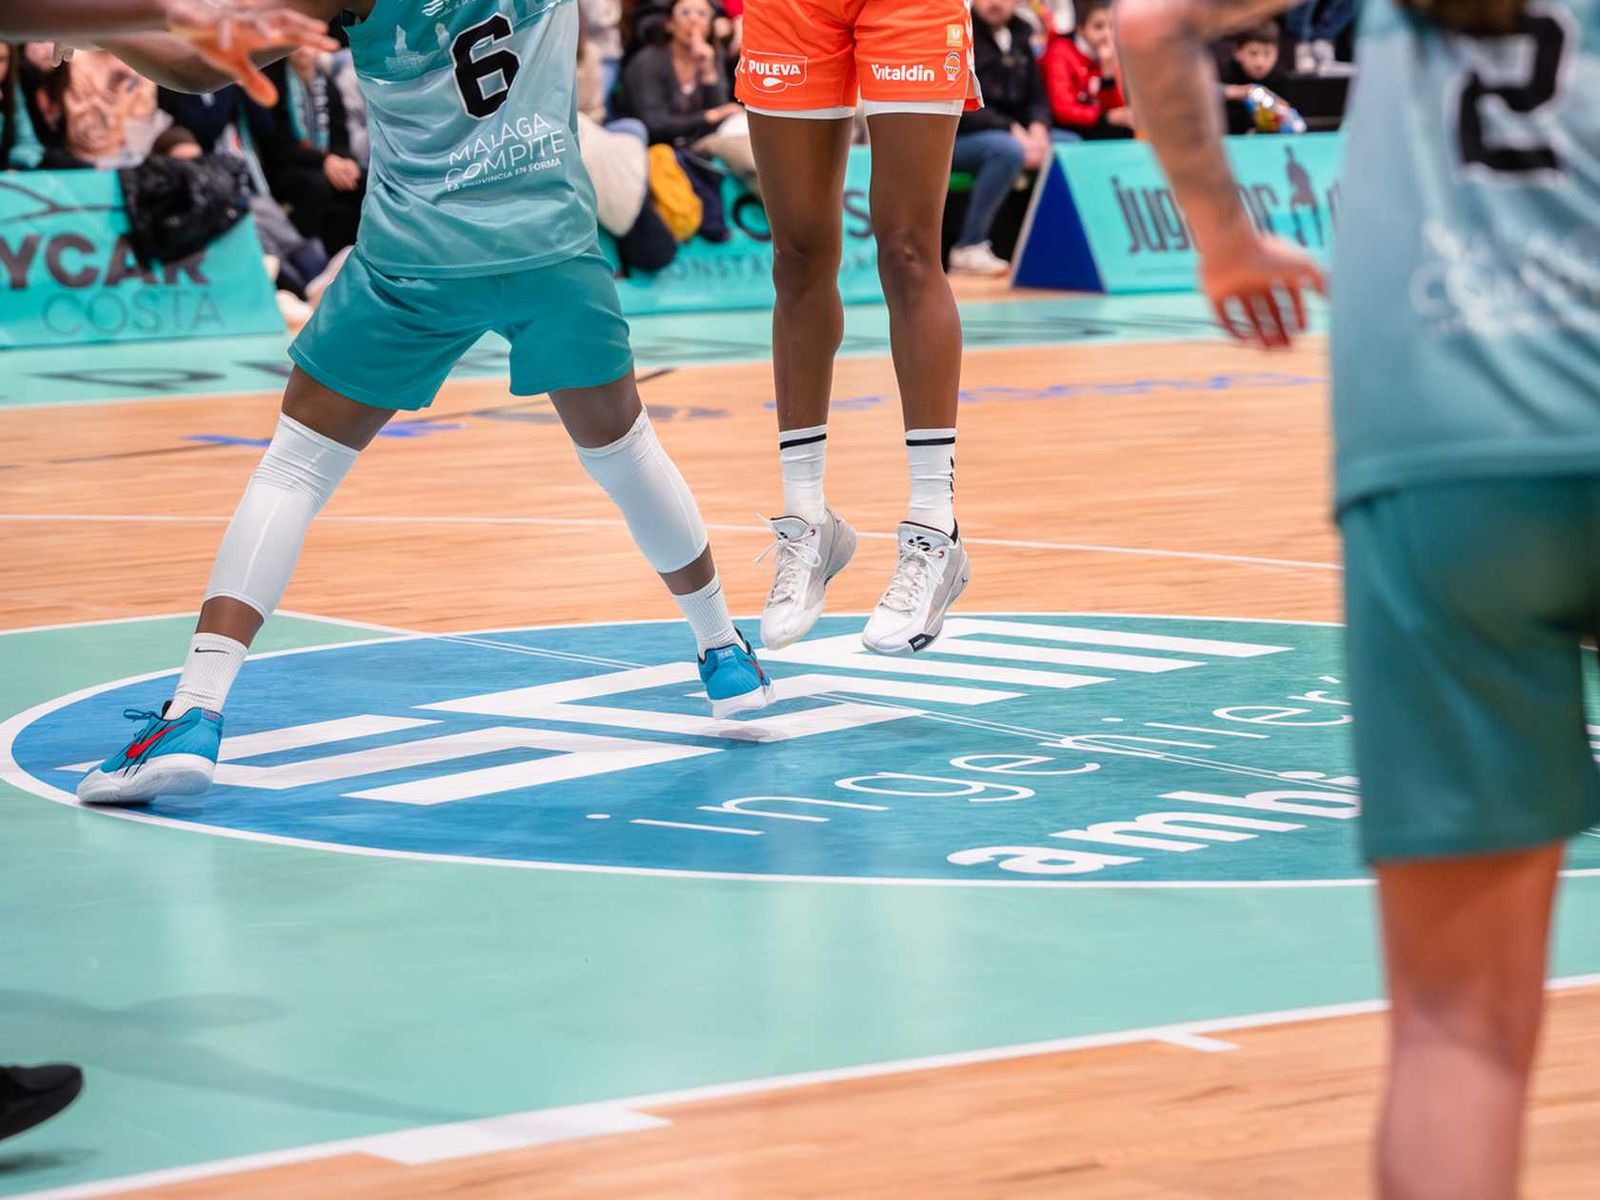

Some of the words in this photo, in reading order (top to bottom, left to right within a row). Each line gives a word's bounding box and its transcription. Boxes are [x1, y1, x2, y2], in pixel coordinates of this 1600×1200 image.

[450, 12, 521, 121] 6
[749, 59, 801, 76] PULEVA
[871, 64, 935, 82] Vitaldin
[1446, 2, 1577, 182] 2
[444, 130, 566, 185] COMPITE
[528, 157, 562, 173] FORMA
[42, 289, 225, 336] COSTA
[585, 674, 1354, 836] ingenier
